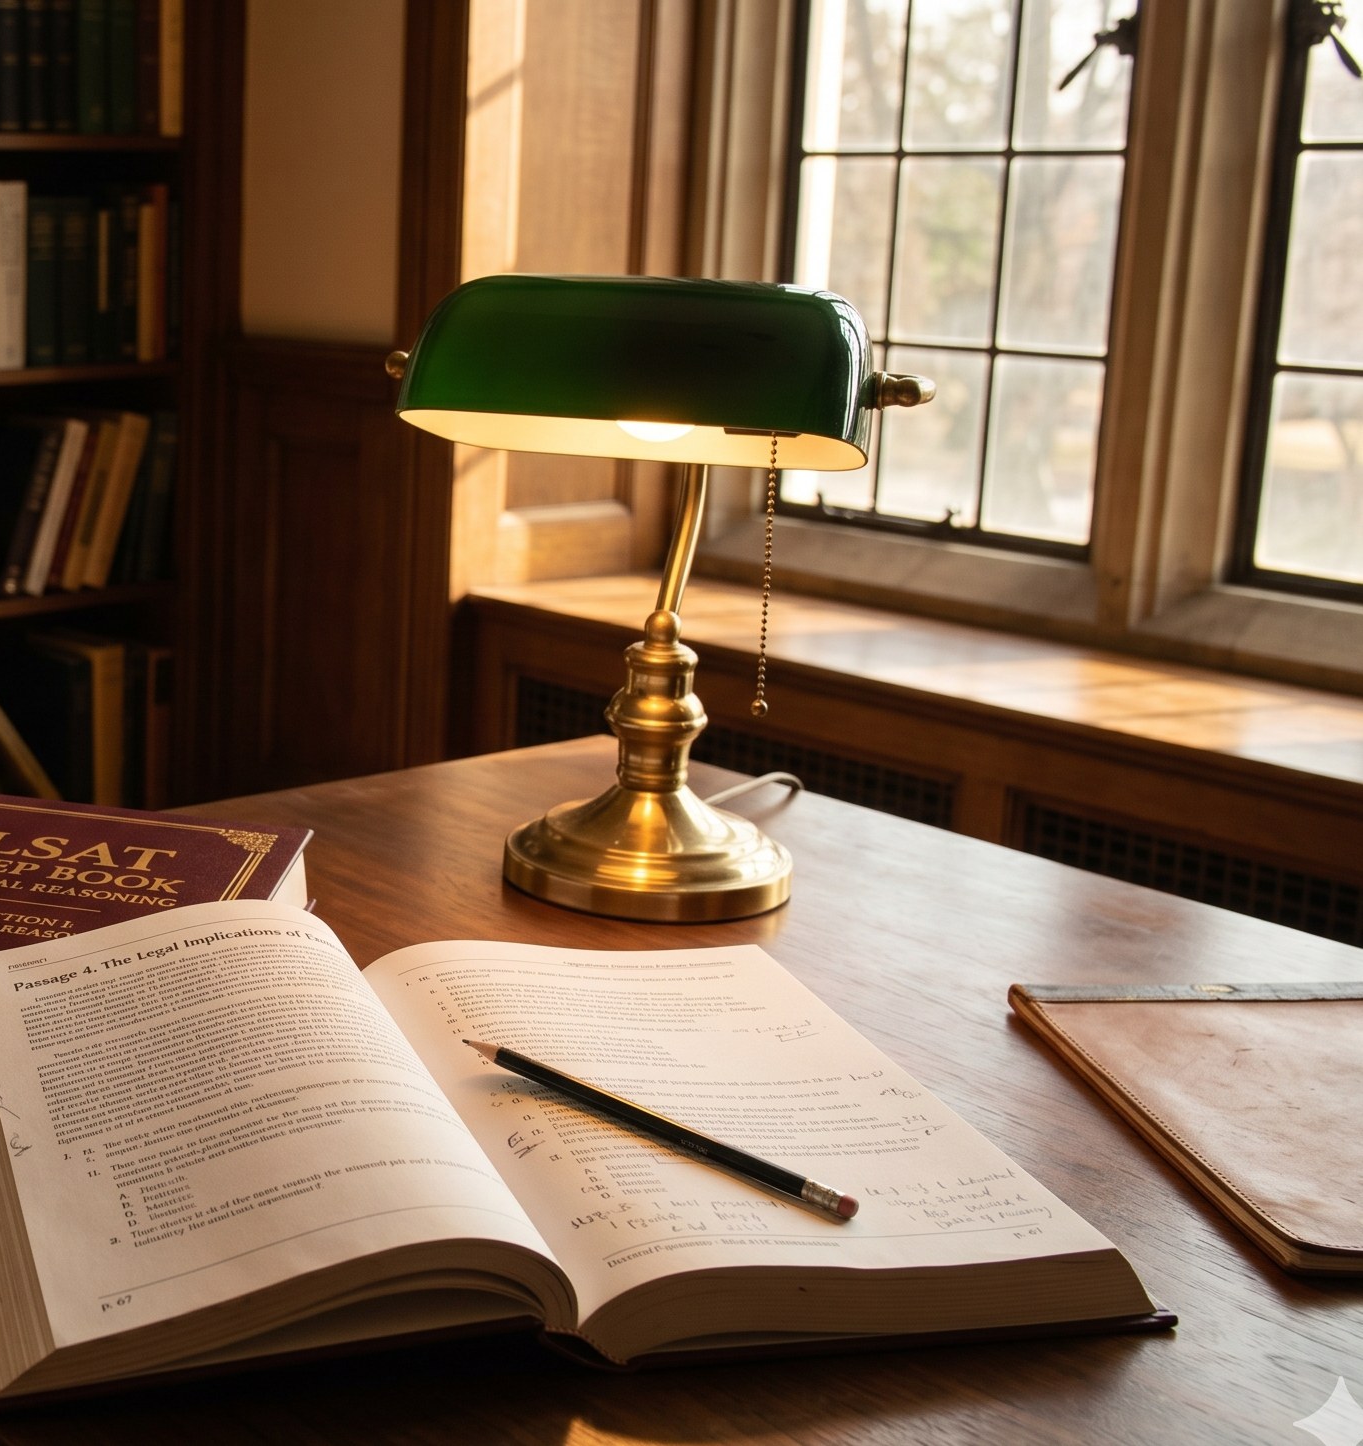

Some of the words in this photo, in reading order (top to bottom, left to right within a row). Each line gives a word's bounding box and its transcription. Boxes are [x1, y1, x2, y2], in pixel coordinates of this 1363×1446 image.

[46, 865, 186, 894] BOOK
[29, 882, 178, 907] REASONING
[13, 971, 78, 992] Passage
[82, 965, 97, 976] 4.
[101, 956, 132, 970] The
[137, 942, 179, 960] Legal
[183, 928, 281, 947] Implications
[286, 929, 303, 938] of
